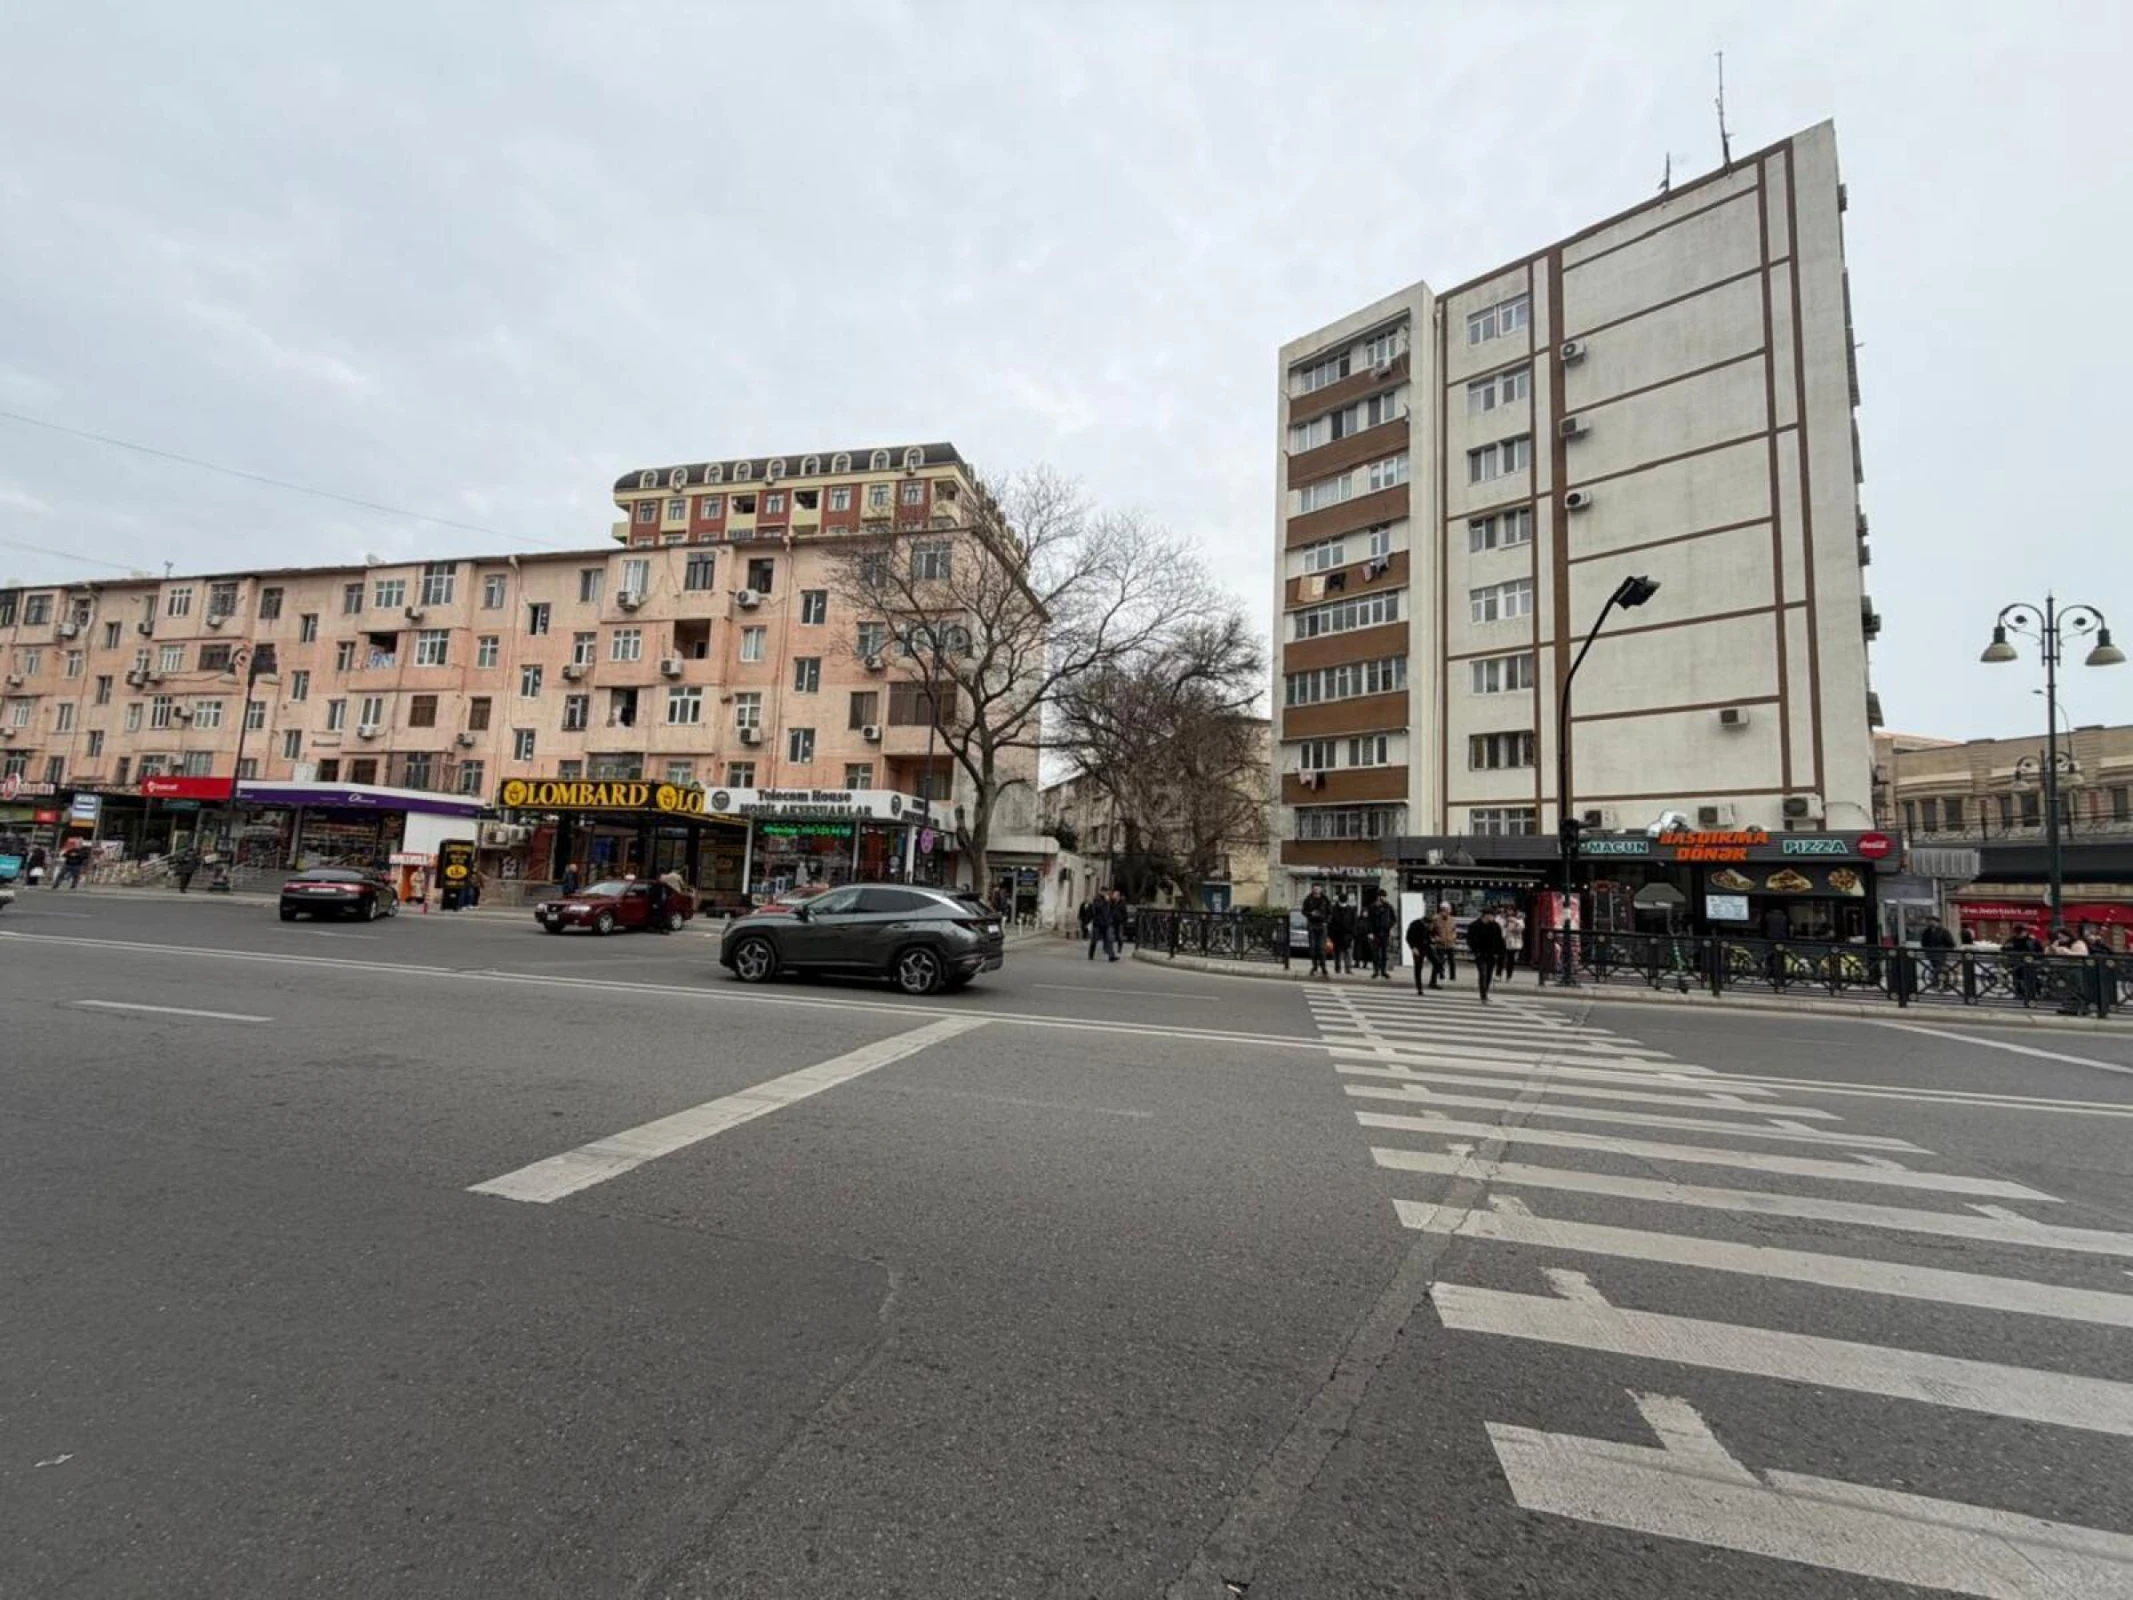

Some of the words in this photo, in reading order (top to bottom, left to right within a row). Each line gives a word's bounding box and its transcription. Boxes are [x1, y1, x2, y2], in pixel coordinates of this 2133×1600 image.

[527, 783, 649, 806] LOMBARD
[757, 790, 809, 802] Telecom
[812, 790, 852, 803] House
[1783, 839, 1849, 854] PIZZA
